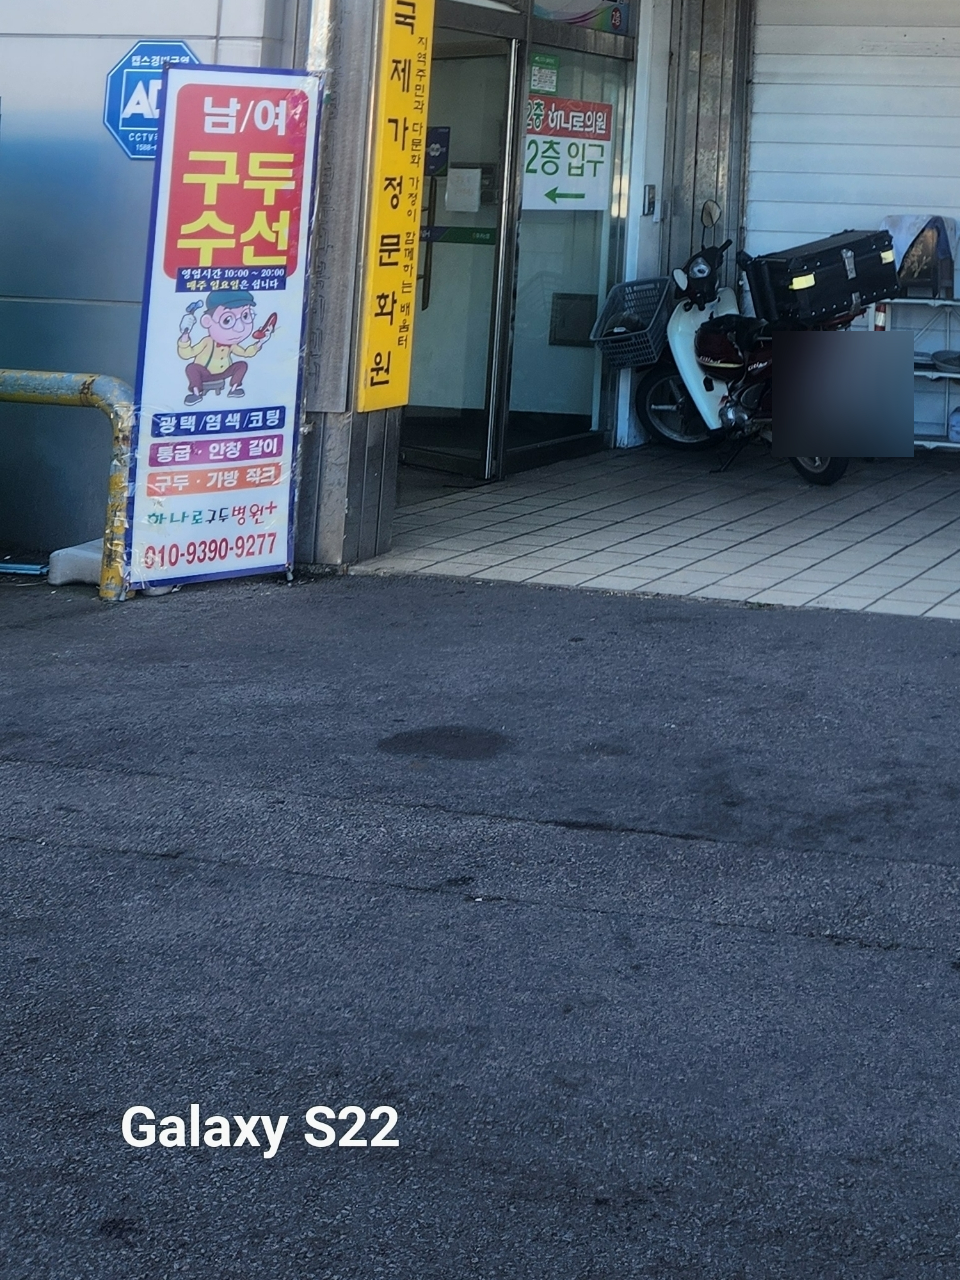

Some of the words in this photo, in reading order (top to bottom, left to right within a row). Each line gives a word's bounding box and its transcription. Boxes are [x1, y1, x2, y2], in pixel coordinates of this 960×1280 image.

[412, 36, 429, 115] 지역주민과
[204, 96, 287, 136] 남/여
[410, 122, 423, 168] 다문화
[525, 138, 561, 176] 2층
[567, 142, 605, 178] 입구
[182, 151, 296, 206] 구두
[369, 0, 417, 388] 국제가정문화원
[406, 176, 420, 224] 가정이
[176, 210, 291, 267] 수선
[181, 268, 222, 280] 영업시간
[224, 269, 249, 278] 10:00
[260, 268, 285, 278] 20:00
[210, 279, 249, 291] 일요일은
[401, 231, 416, 295] 함께하는
[397, 302, 411, 350] 배움터
[156, 443, 192, 464] 통굽
[208, 441, 242, 460] 안창
[249, 437, 278, 456] 갈이
[154, 474, 189, 492] 구두
[206, 470, 239, 488] 가방
[144, 532, 277, 569] 010-9390-9277
